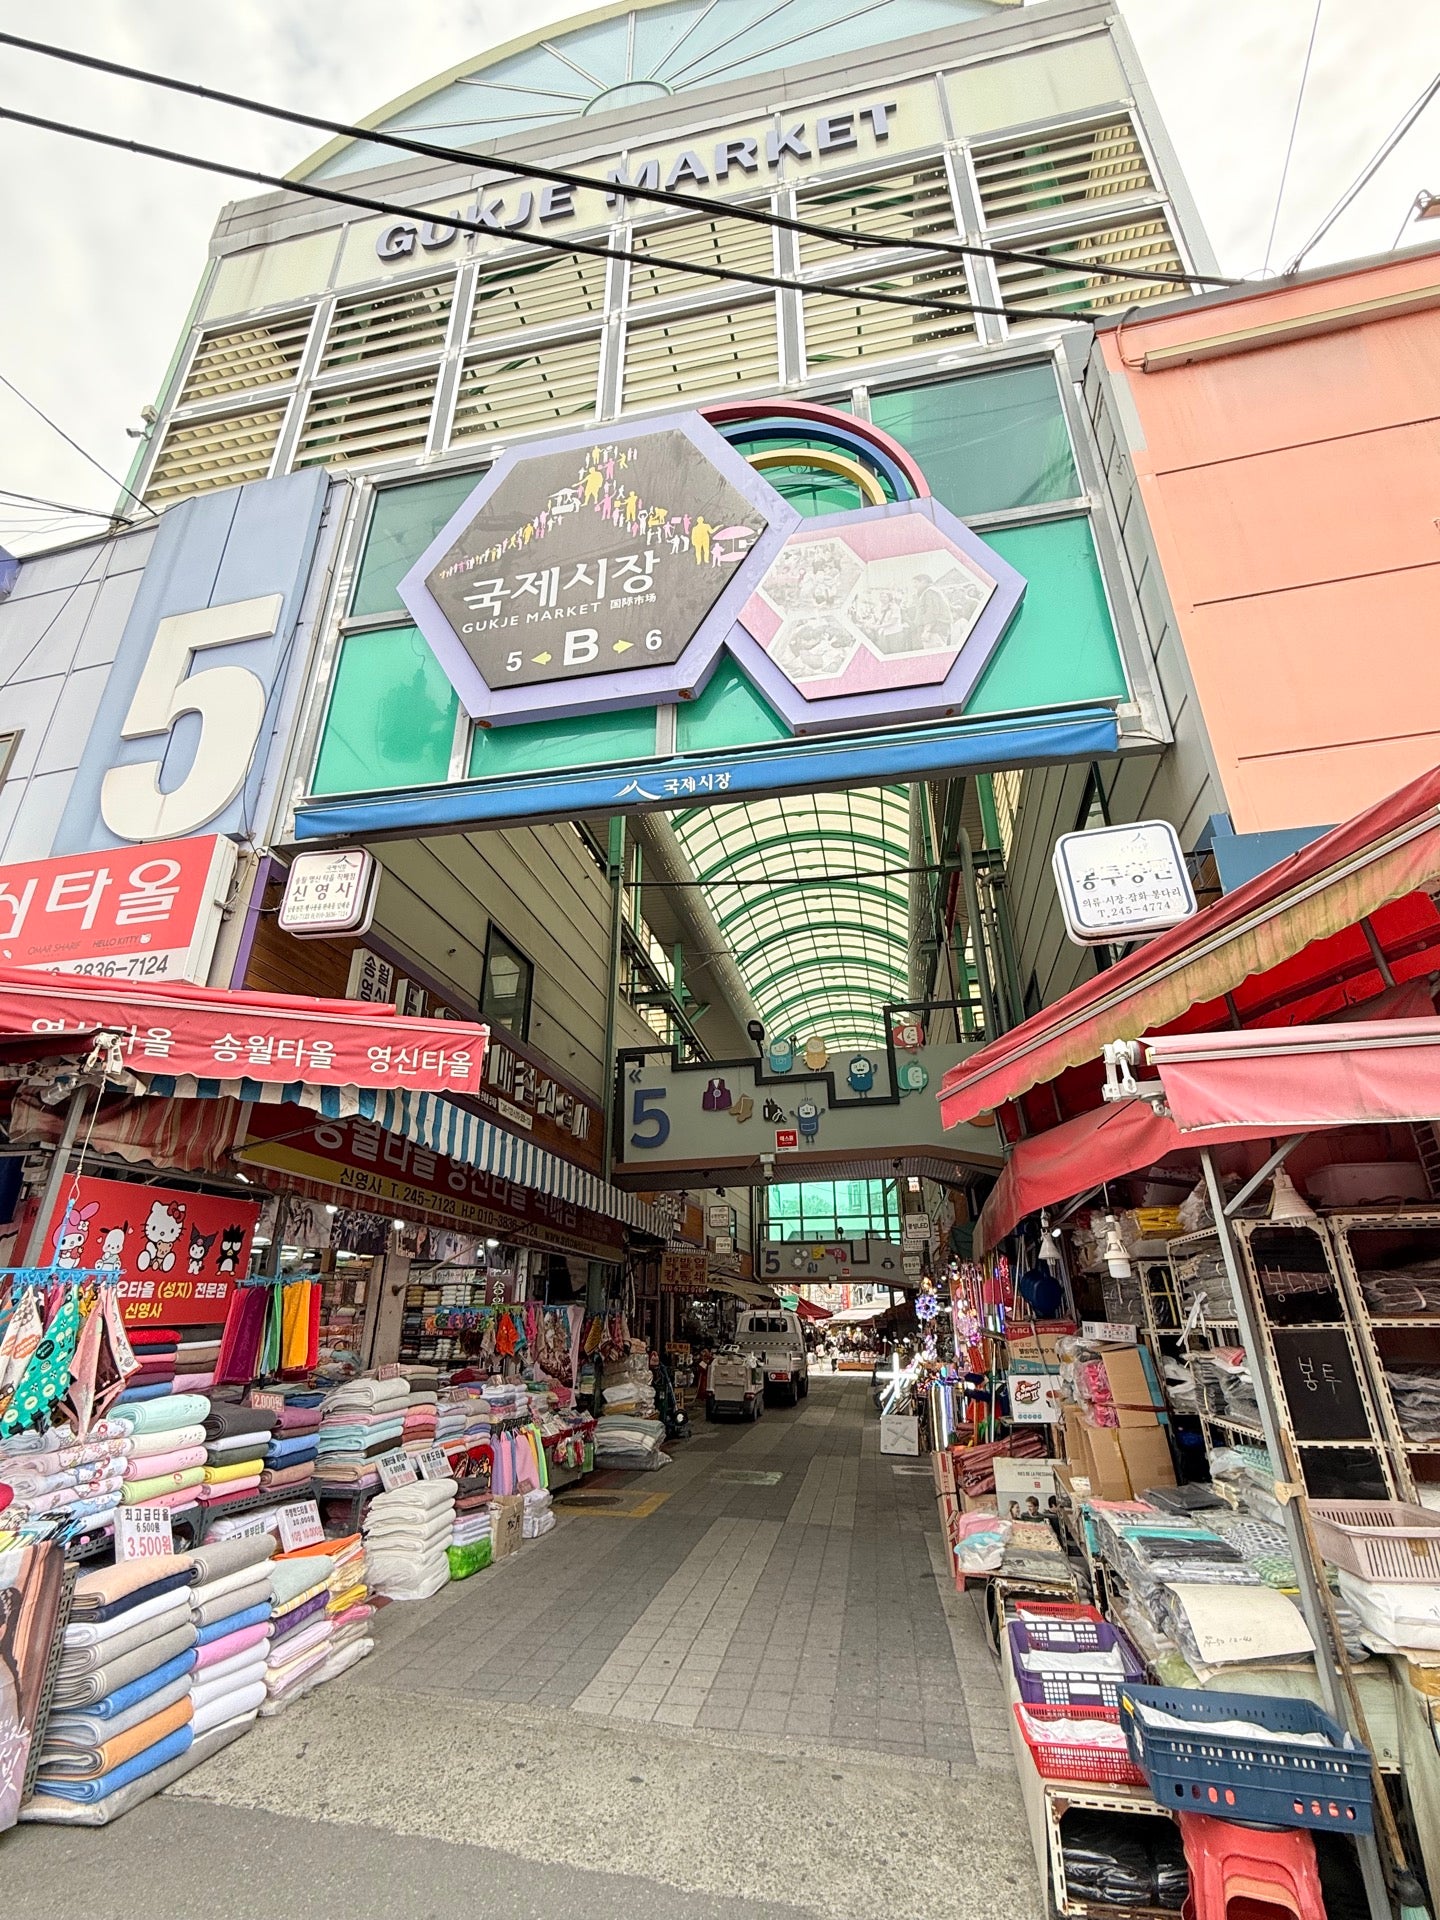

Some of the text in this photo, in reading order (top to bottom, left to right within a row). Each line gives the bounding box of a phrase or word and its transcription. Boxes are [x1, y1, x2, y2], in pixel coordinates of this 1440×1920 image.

[375, 102, 897, 261] GUKJE MARKET
[463, 551, 660, 616] 국제시장
[609, 593, 657, 610] 国际市场
[462, 602, 601, 634] GUKJE MARKET
[505, 628, 662, 672] 5 B 6
[101, 593, 284, 842] 5
[663, 772, 732, 794] 국제시장
[93, 937, 117, 947] HELLO
[117, 934, 140, 945] KITTY
[210, 1033, 337, 1069] 송월타올
[367, 1045, 473, 1078] 영신타올
[630, 1088, 671, 1149] 5
[340, 1167, 382, 1194] 신영사
[404, 1187, 456, 1214] 245-7123
[766, 1251, 780, 1273] 5
[158, 1282, 193, 1299] (성지)
[195, 1282, 228, 1298] 전문점
[125, 1302, 162, 1319] 신영사
[128, 1535, 172, 1557] 3.500원
